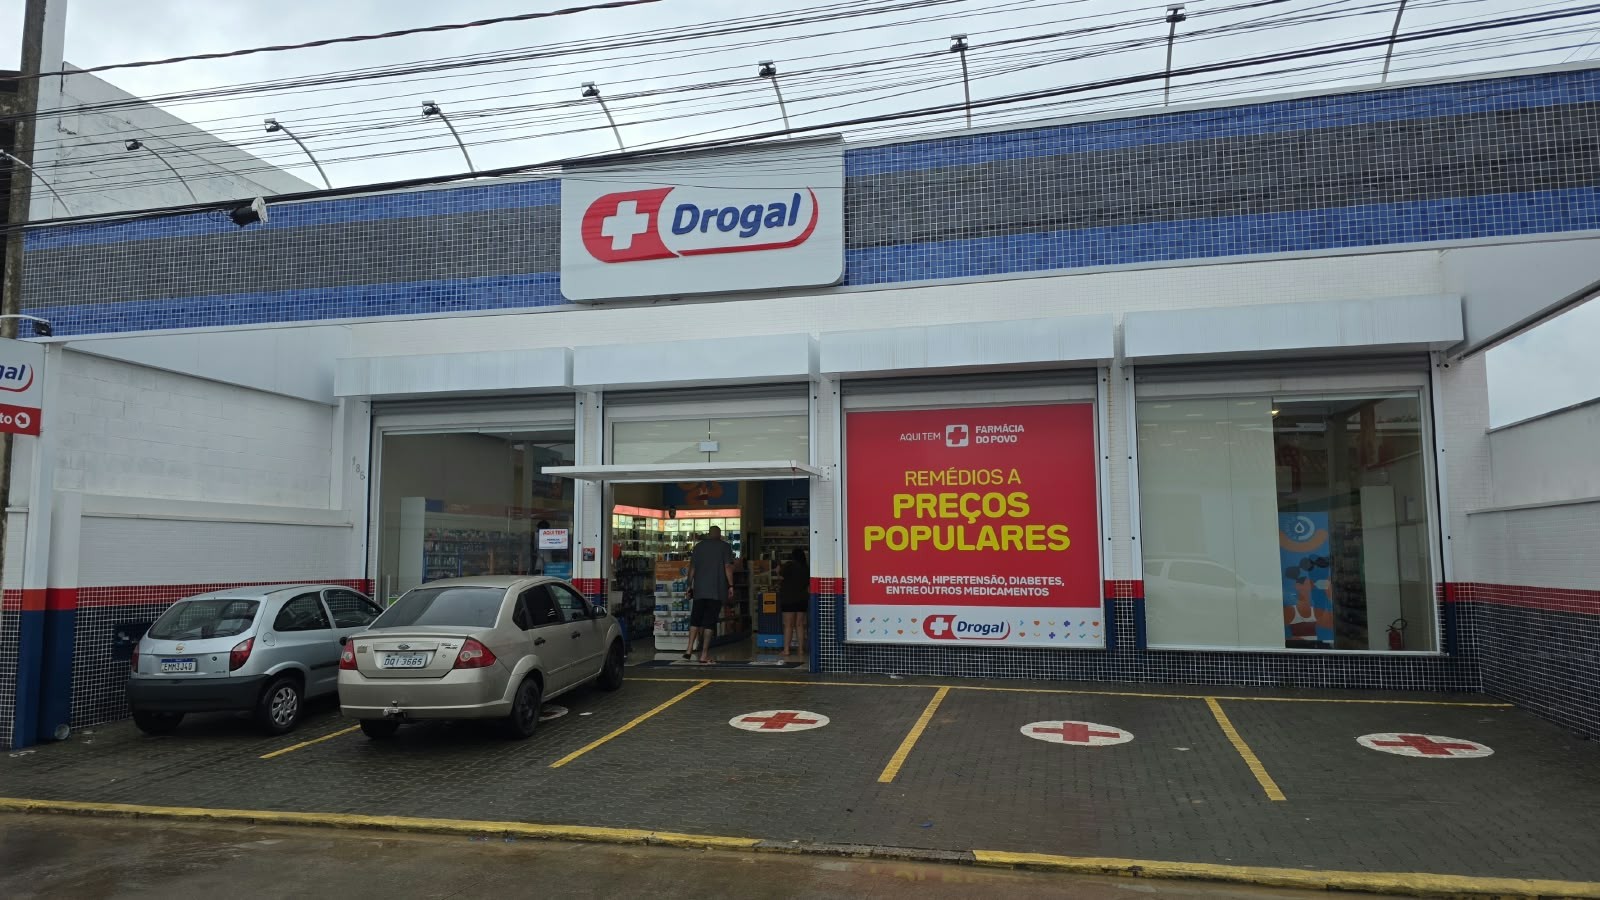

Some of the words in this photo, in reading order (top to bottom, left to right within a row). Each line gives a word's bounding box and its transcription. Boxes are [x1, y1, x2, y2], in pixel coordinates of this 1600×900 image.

[671, 192, 802, 239] Drogal
[975, 423, 1025, 434] FARMÁCIA
[899, 432, 921, 442] AQUI
[922, 431, 941, 441] TEM
[975, 435, 990, 444] DO
[990, 434, 1018, 444] POVO
[904, 466, 1004, 487] REMÉDIOS
[1007, 468, 1022, 485] A
[893, 491, 1031, 524] PREÇOS
[864, 524, 1071, 551] POPULARES
[871, 575, 899, 584] PARA
[899, 575, 931, 585] ASMA,
[932, 574, 1008, 586] HIPERTENSÃO,
[1009, 576, 1065, 587] DIABETES,
[886, 586, 920, 595] ENTRE
[920, 586, 962, 595] OUTROS
[963, 587, 1050, 596] MEDICAMENTOS
[956, 620, 1005, 636] Drogal
